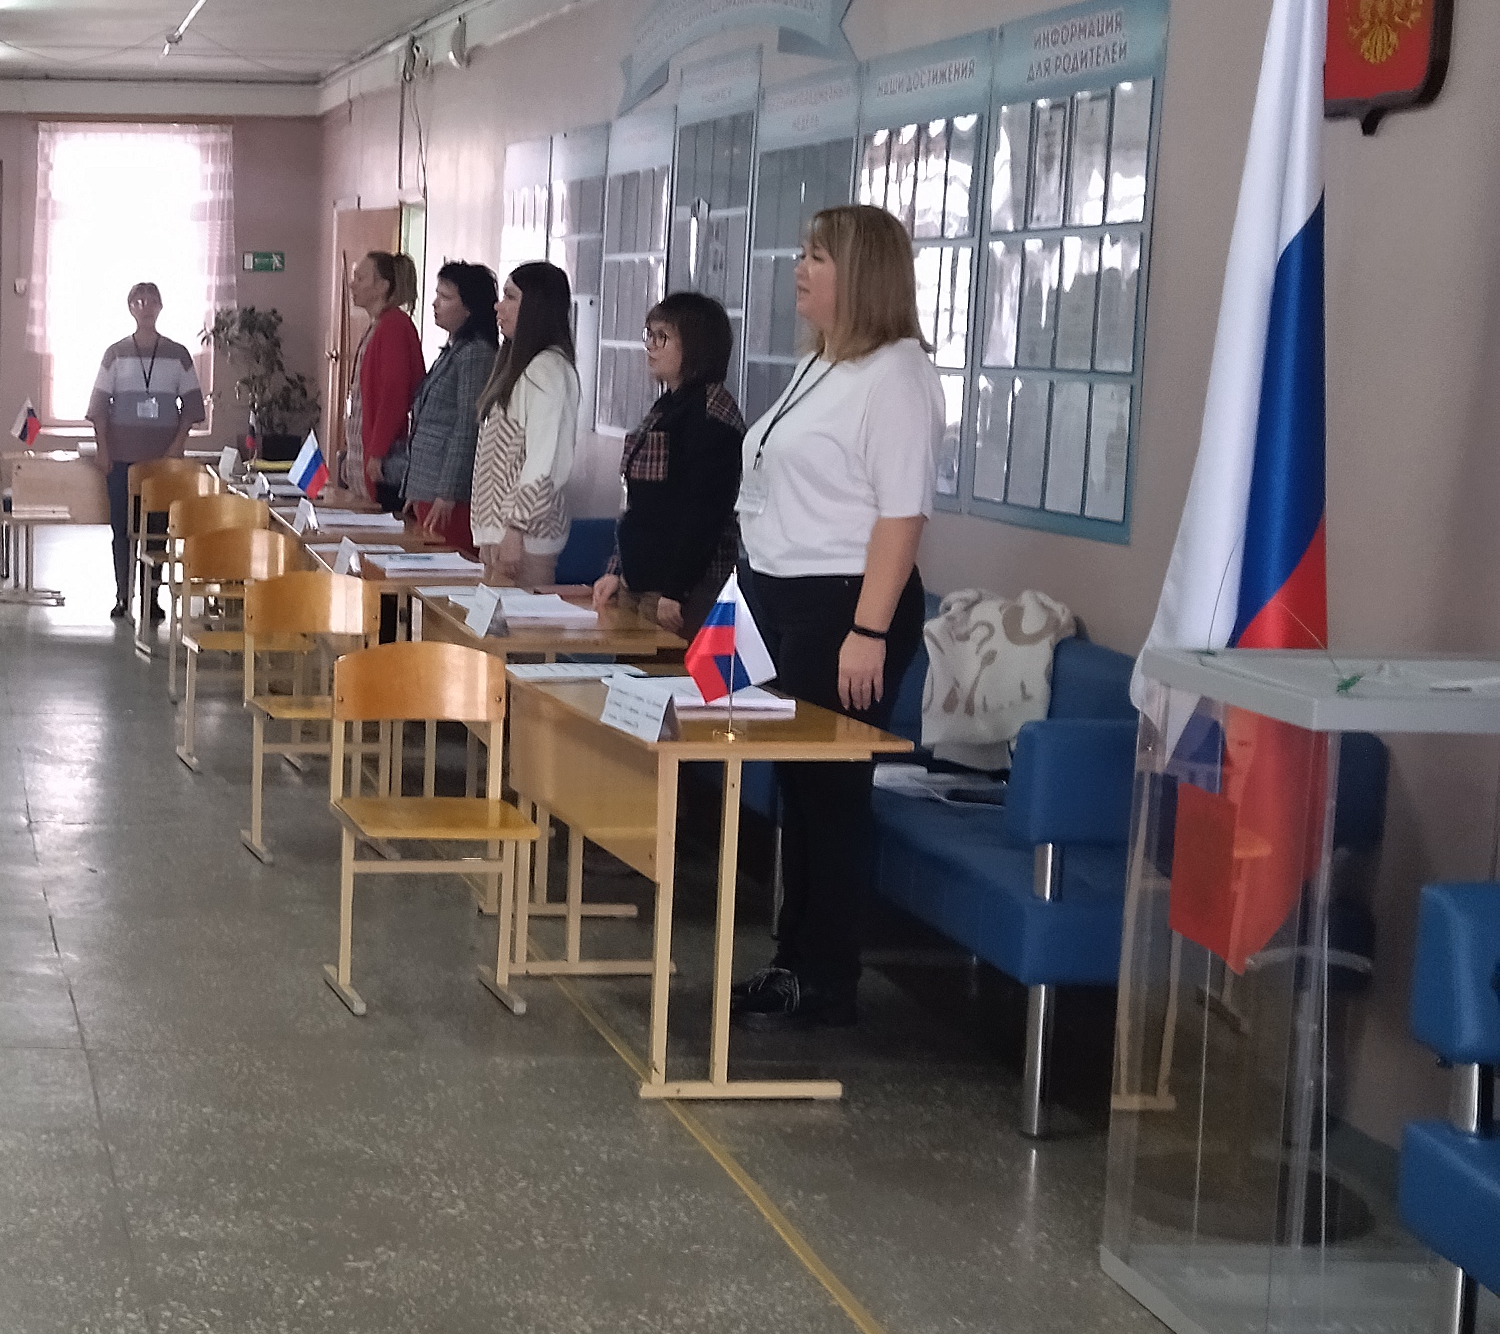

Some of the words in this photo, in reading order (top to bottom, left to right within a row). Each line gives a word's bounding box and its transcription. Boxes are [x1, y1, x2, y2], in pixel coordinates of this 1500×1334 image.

[1033, 11, 1123, 49] ИНФОРМАЦИЯ
[905, 58, 975, 94] ДОСТИЖЕНИЯ
[1026, 57, 1051, 83] ДЛЯ
[1054, 33, 1128, 75] РОДИТЕЛЕЙ
